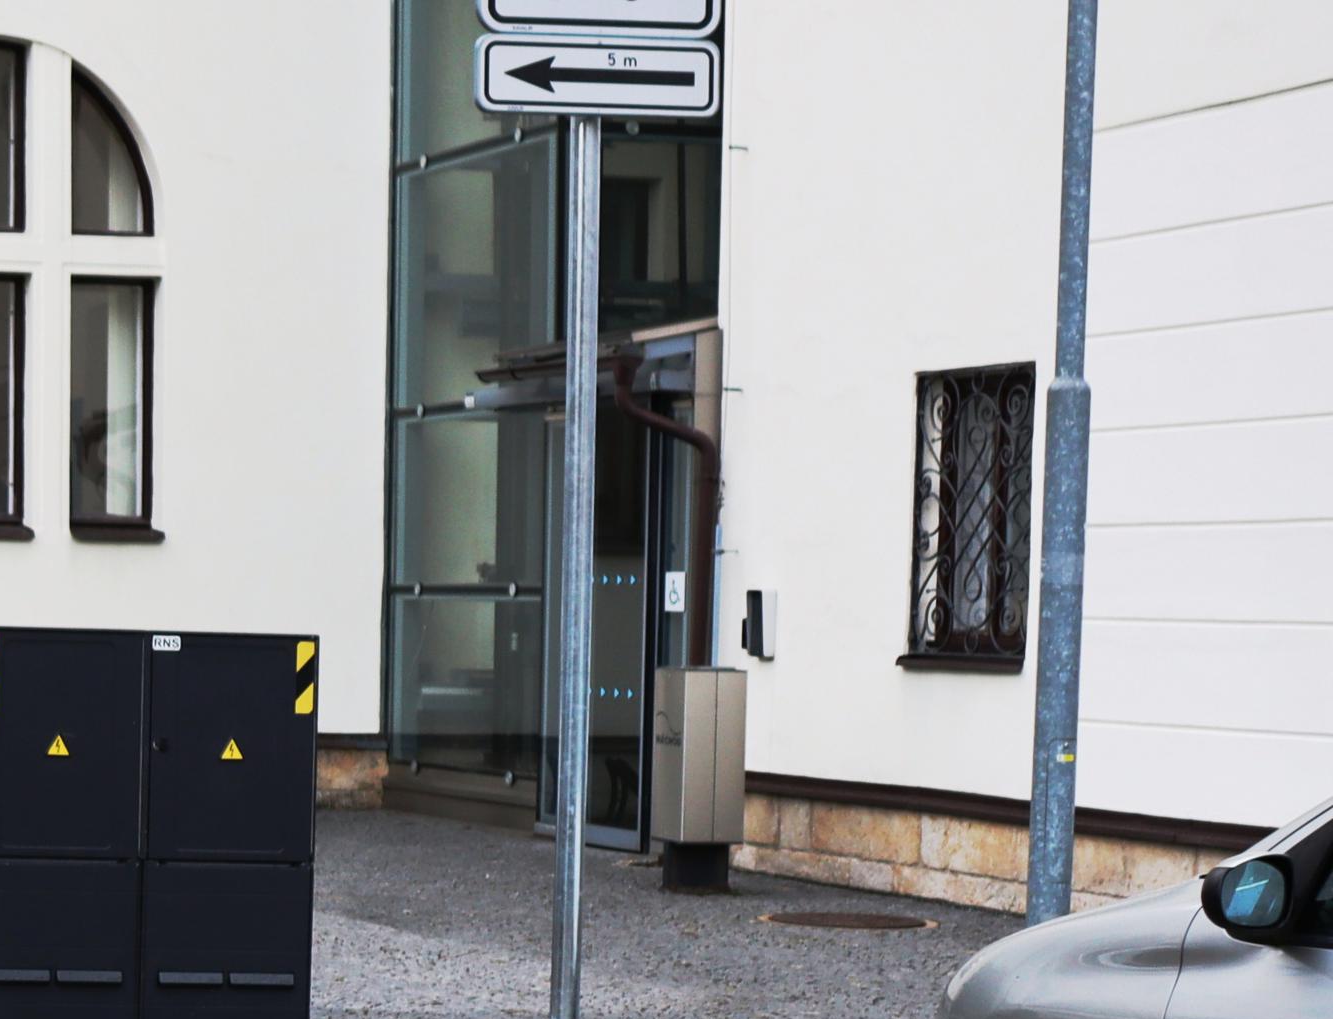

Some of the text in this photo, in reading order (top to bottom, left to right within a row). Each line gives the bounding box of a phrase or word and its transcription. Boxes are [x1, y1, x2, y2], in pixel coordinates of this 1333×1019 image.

[607, 52, 638, 68] 5 m
[154, 637, 180, 648] RNS
